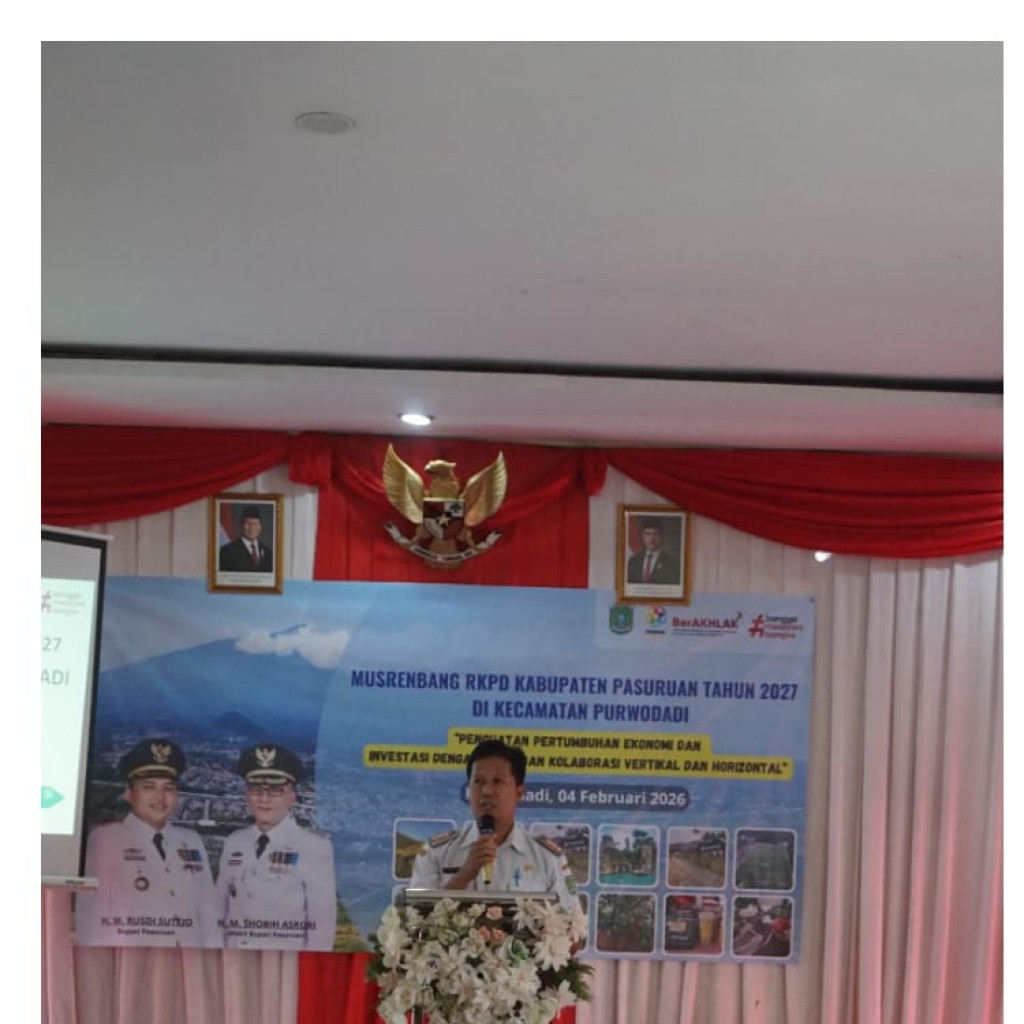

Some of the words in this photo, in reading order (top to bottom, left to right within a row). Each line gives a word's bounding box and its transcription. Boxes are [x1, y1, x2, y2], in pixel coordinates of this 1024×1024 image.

[672, 616, 738, 628] BerAKHLAK
[350, 669, 460, 690] MUSRENBANG
[466, 673, 509, 692] RKPD
[515, 675, 607, 695] KABUPATEN
[612, 677, 699, 698] PASURUAN
[703, 680, 755, 699] TAHUN
[760, 683, 798, 701] 2027
[472, 699, 489, 718] DI
[494, 701, 588, 721] KECAMATAN
[593, 704, 689, 723] PURWODADI
[534, 735, 619, 750] PERTUMBUHAN
[624, 738, 673, 750] EKONOMI
[677, 740, 702, 751] DAN
[369, 750, 429, 763] INVESTASI
[433, 752, 470, 765] DENGA
[548, 756, 620, 769] KOLABORASI
[624, 758, 680, 771] VERTIKAL
[684, 760, 708, 772] DAN
[558, 789, 576, 803] 04
[580, 789, 645, 804] Februari
[650, 791, 687, 807] 2026
